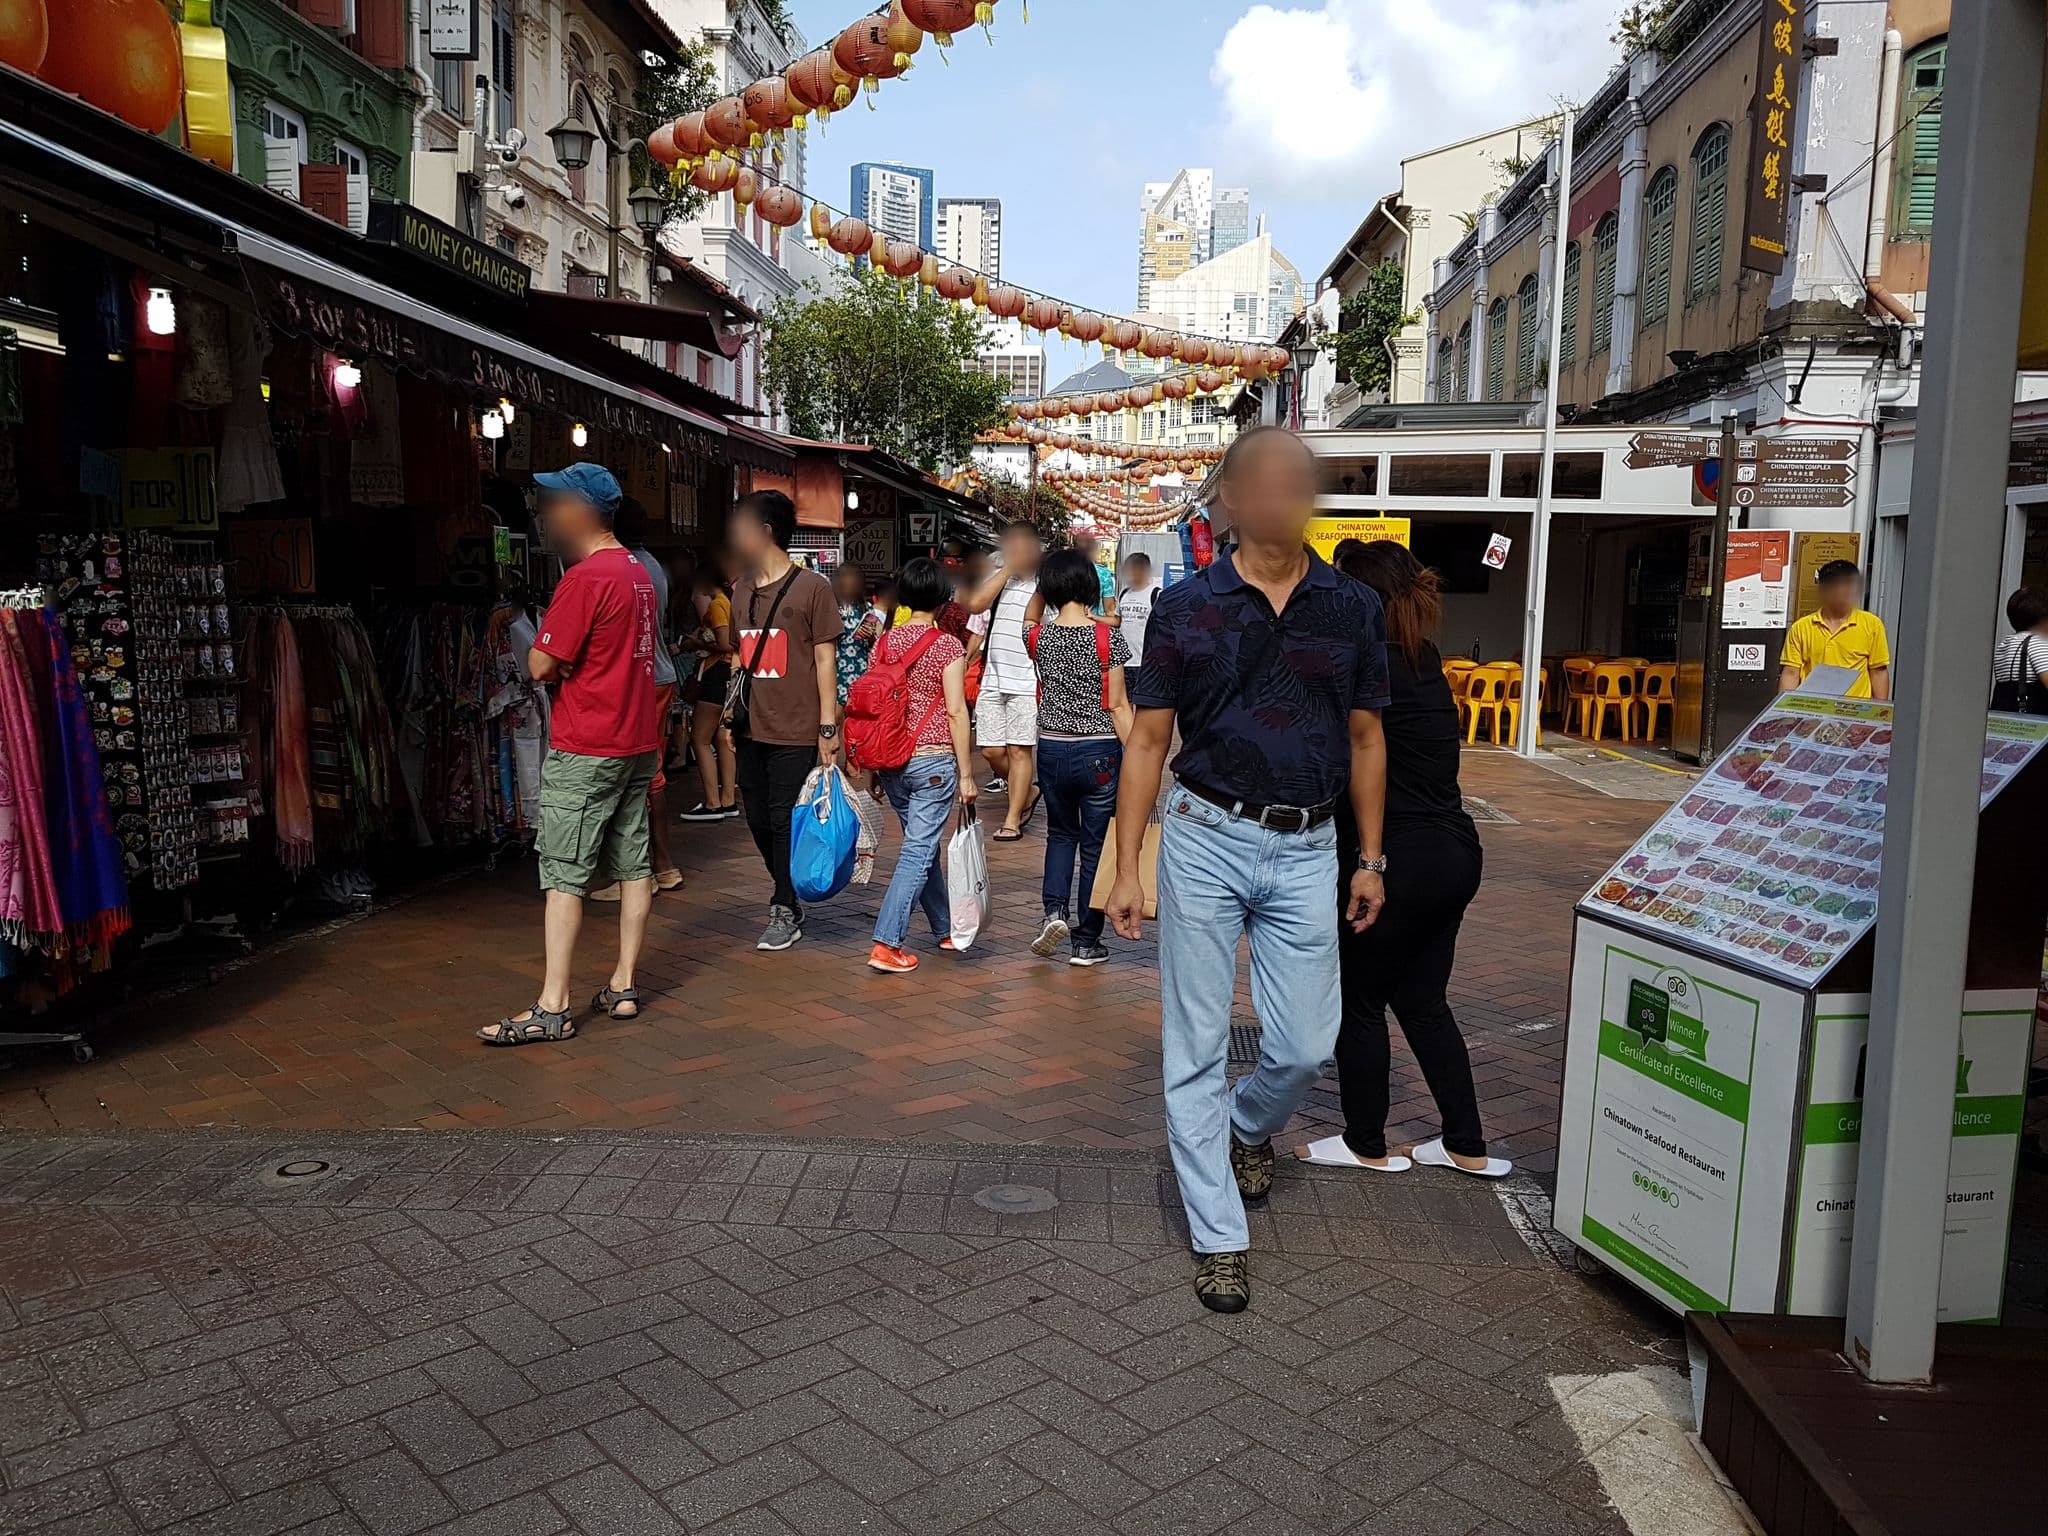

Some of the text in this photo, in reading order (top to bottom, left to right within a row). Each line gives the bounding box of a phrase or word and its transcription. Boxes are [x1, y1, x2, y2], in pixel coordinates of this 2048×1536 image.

[404, 215, 526, 298] MONEY CHANGER
[471, 349, 485, 385] 3
[488, 354, 514, 394] for
[1667, 434, 1687, 442] HERITAGE
[129, 480, 177, 508] FOR
[176, 453, 215, 525] 10
[861, 529, 890, 540] SALE
[1315, 532, 1406, 542] SEAFOOD RESTAURANT
[1336, 523, 1386, 532] CHINATOWN
[1669, 1020, 1697, 1041] Winner
[1619, 1041, 1724, 1100] Certificate of Excellence
[1651, 1104, 1677, 1123] Awarded to
[1953, 1110, 1992, 1125] llence
[1603, 1106, 1726, 1182] Chinatown Seafood Restaurant
[1816, 1189, 1995, 1212] Chinat staurant
